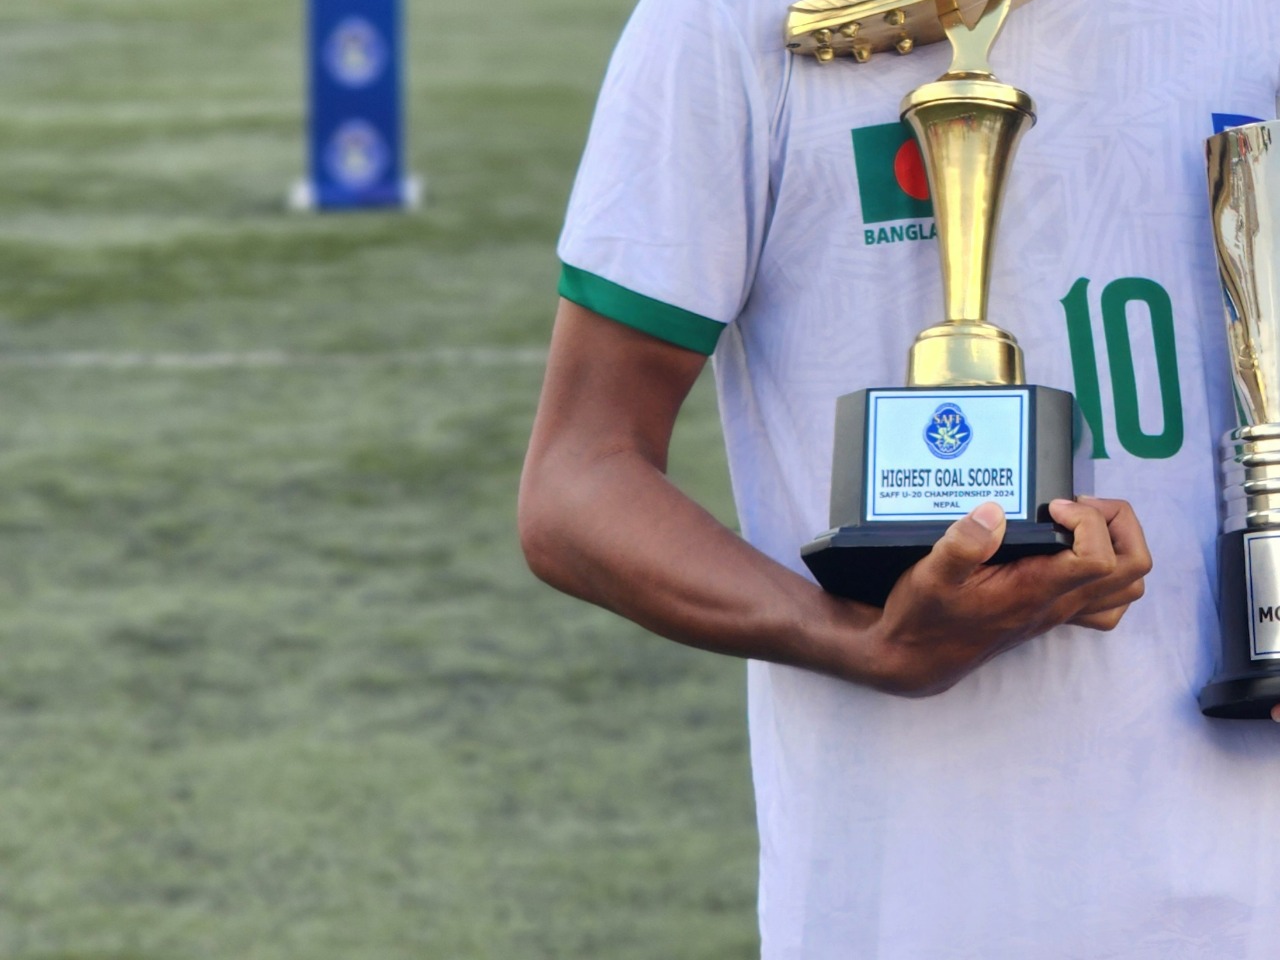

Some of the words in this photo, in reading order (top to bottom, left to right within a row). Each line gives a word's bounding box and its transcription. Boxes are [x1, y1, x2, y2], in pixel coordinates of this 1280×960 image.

[1060, 276, 1185, 460] 10
[881, 468, 932, 488] HIGHEST
[934, 468, 965, 487] GOAL
[967, 467, 1014, 487] SCORER
[879, 491, 900, 499] SAFF
[924, 490, 992, 498] CHAMPIONSHIP
[993, 490, 1015, 498] 2024
[933, 501, 961, 509] NEPAL
